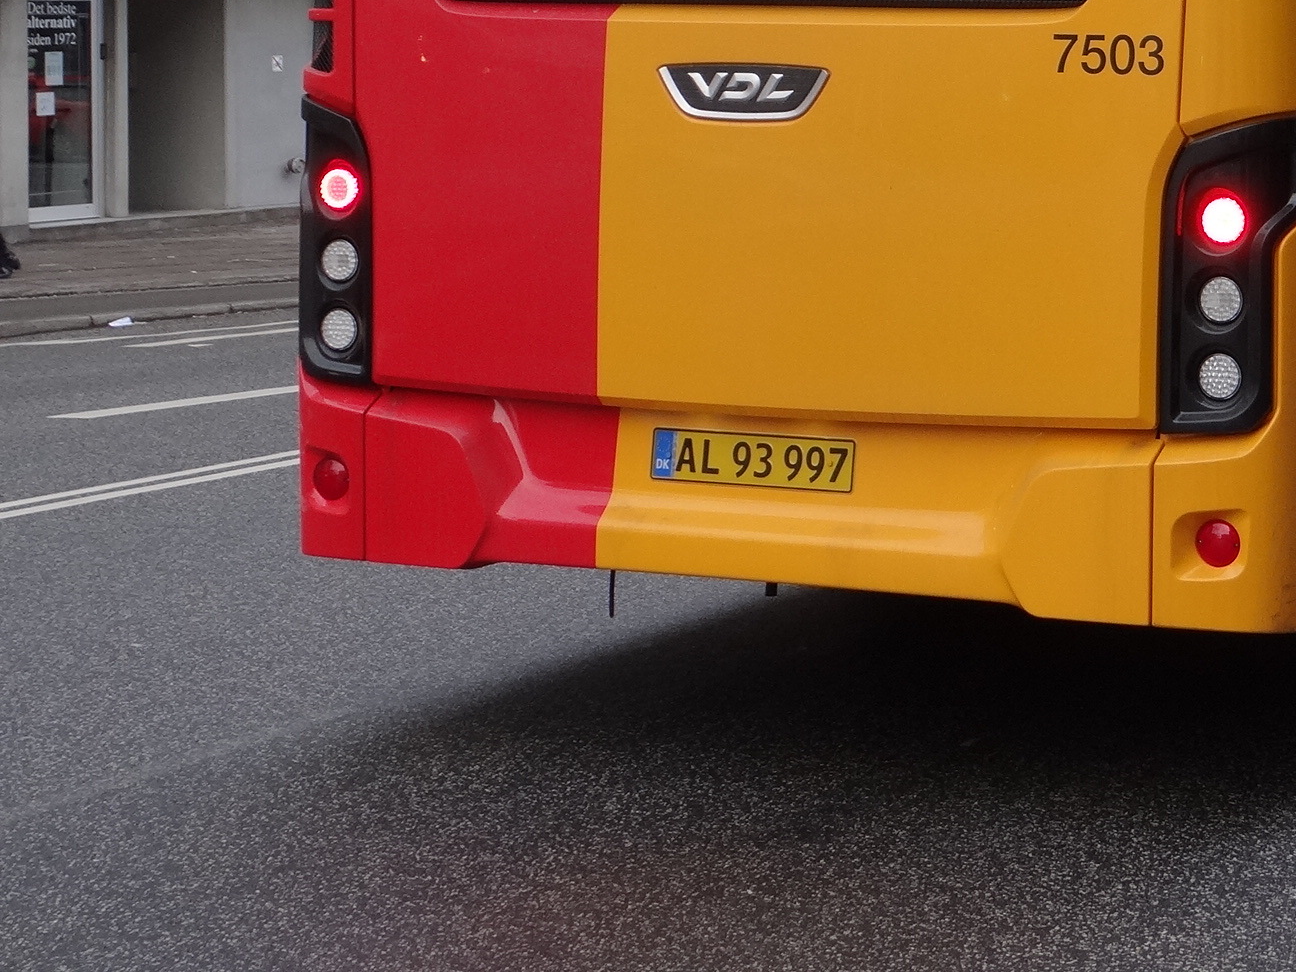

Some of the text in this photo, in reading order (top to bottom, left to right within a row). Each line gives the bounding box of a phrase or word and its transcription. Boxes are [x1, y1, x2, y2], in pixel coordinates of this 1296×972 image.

[28, 1, 77, 15] Det bedste
[27, 15, 77, 29] alternativ
[27, 32, 77, 46] siden 1972
[1053, 32, 1165, 76] 7503
[687, 71, 797, 103] VDL
[655, 458, 670, 470] DK
[675, 437, 849, 483] AL 93 997
